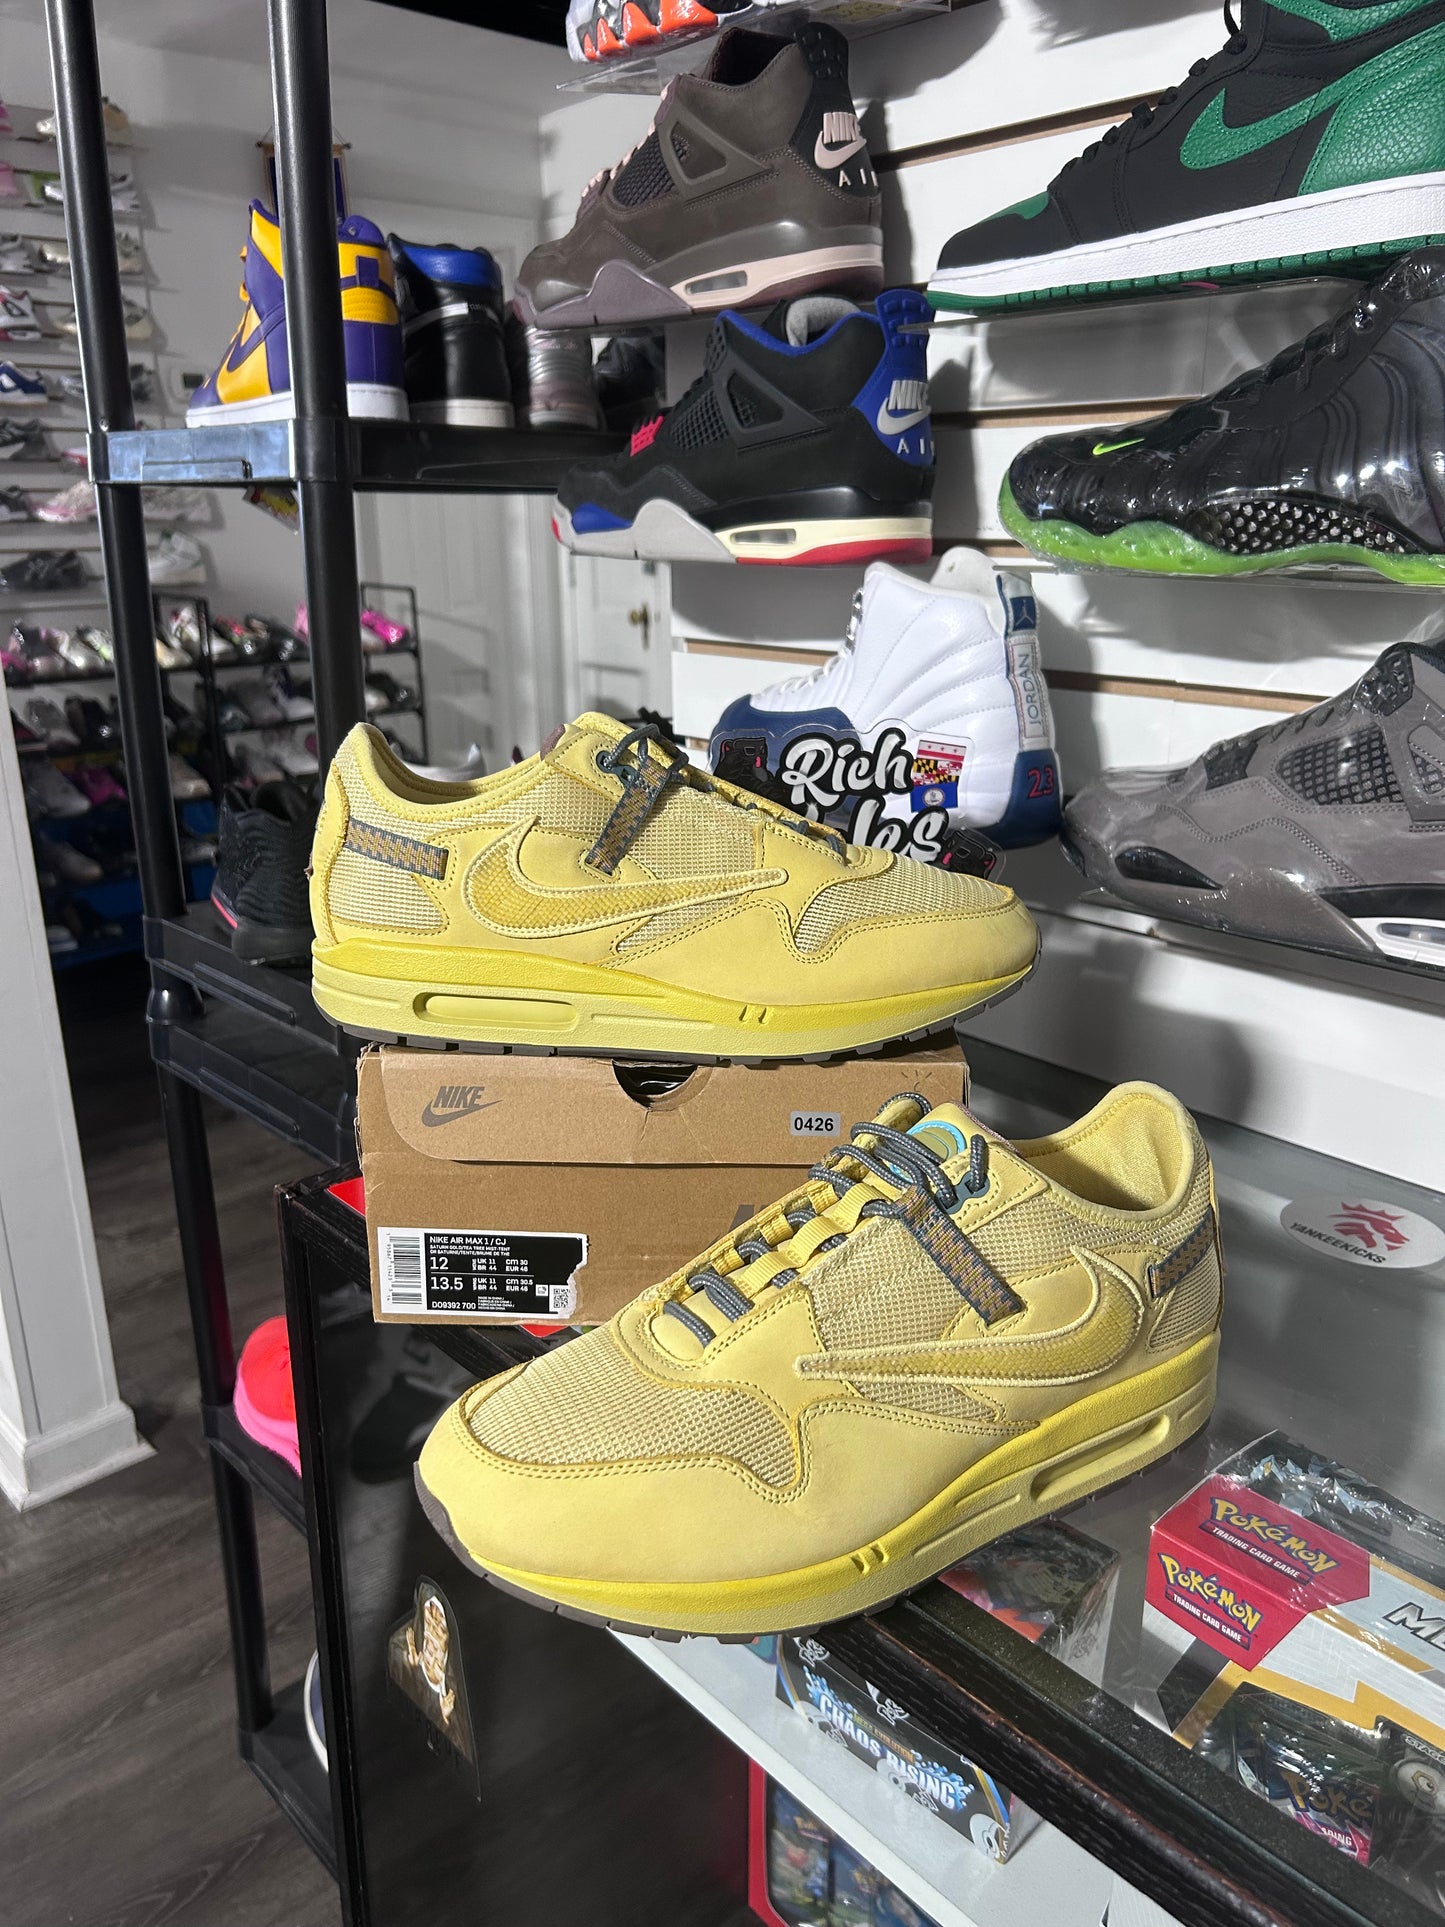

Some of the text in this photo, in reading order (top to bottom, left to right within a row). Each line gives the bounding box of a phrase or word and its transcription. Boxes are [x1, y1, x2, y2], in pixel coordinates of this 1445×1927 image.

[1017, 652, 1042, 726] JORDAN
[780, 732, 909, 807] Rich
[1027, 766, 1055, 799] 23
[432, 1085, 486, 1109] NIKE
[794, 1116, 834, 1132] 0426
[429, 1236, 449, 1244] NIKE
[450, 1236, 464, 1244] AIR
[465, 1237, 483, 1245] MAX
[484, 1237, 489, 1245] 1
[495, 1238, 507, 1246] CJ
[1289, 1221, 1387, 1264] YANKEEKICKS
[429, 1256, 449, 1270] 12
[430, 1276, 464, 1291] 13.5
[520, 1278, 534, 1286] 30.5
[462, 1302, 477, 1310] 700
[1211, 1526, 1301, 1579] TRADING CARD GAME
[1172, 1593, 1244, 1643] TRADING CARD GAME
[818, 1691, 956, 1810] CHAOS RISING
